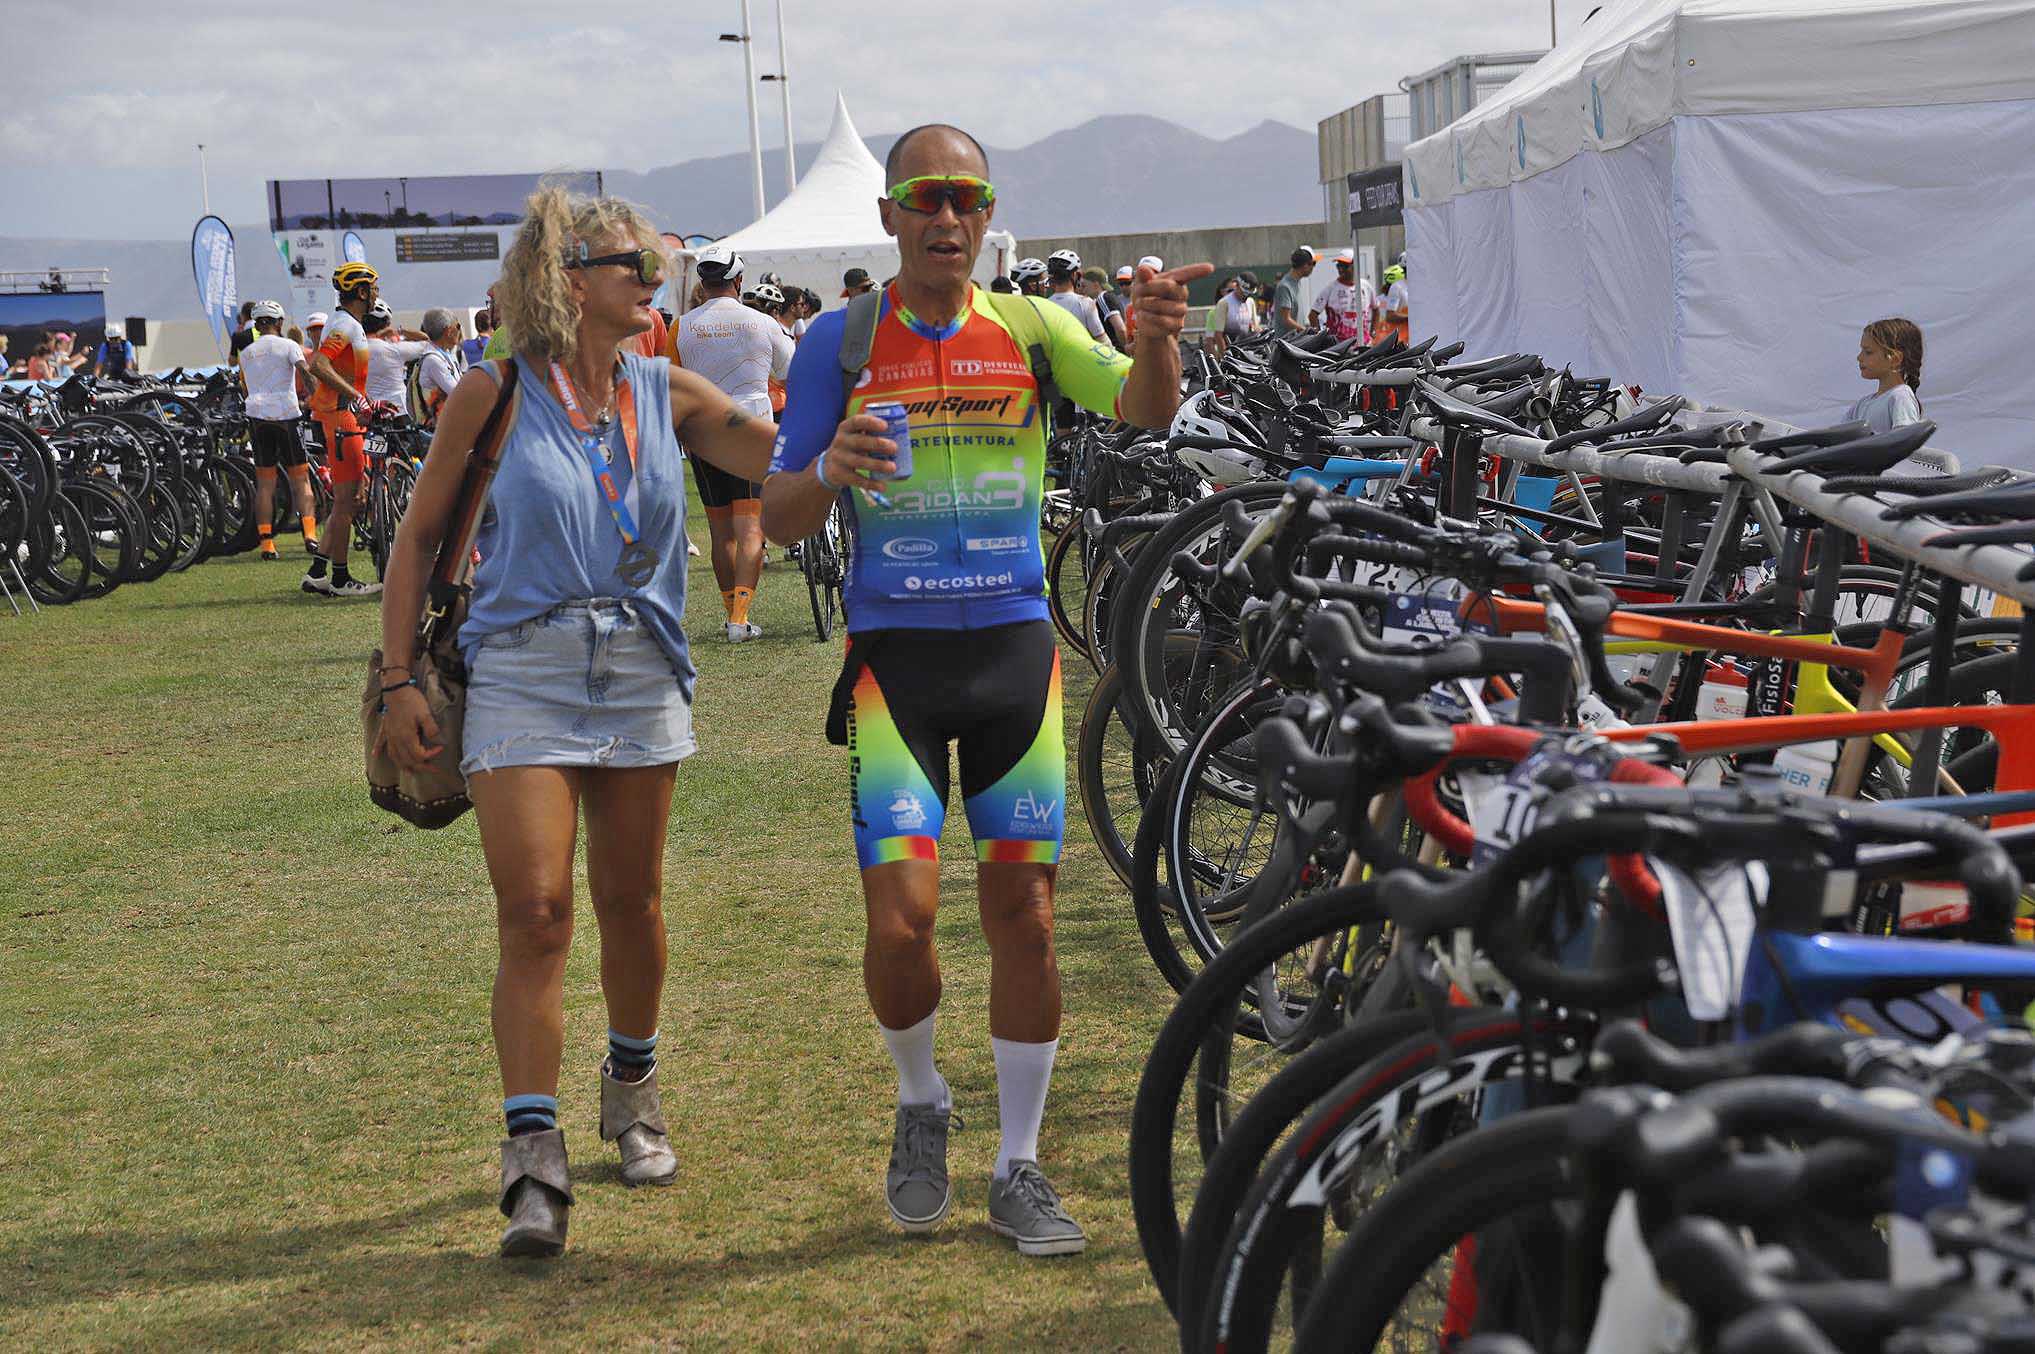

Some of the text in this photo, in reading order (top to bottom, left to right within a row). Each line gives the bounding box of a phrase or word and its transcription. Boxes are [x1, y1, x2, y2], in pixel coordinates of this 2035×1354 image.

[955, 363, 980, 374] TD
[941, 395, 1011, 417] Sport
[911, 436, 1015, 448] RTEVENTURA
[980, 539, 1016, 548] SPAR
[924, 572, 1013, 590] ecosteel
